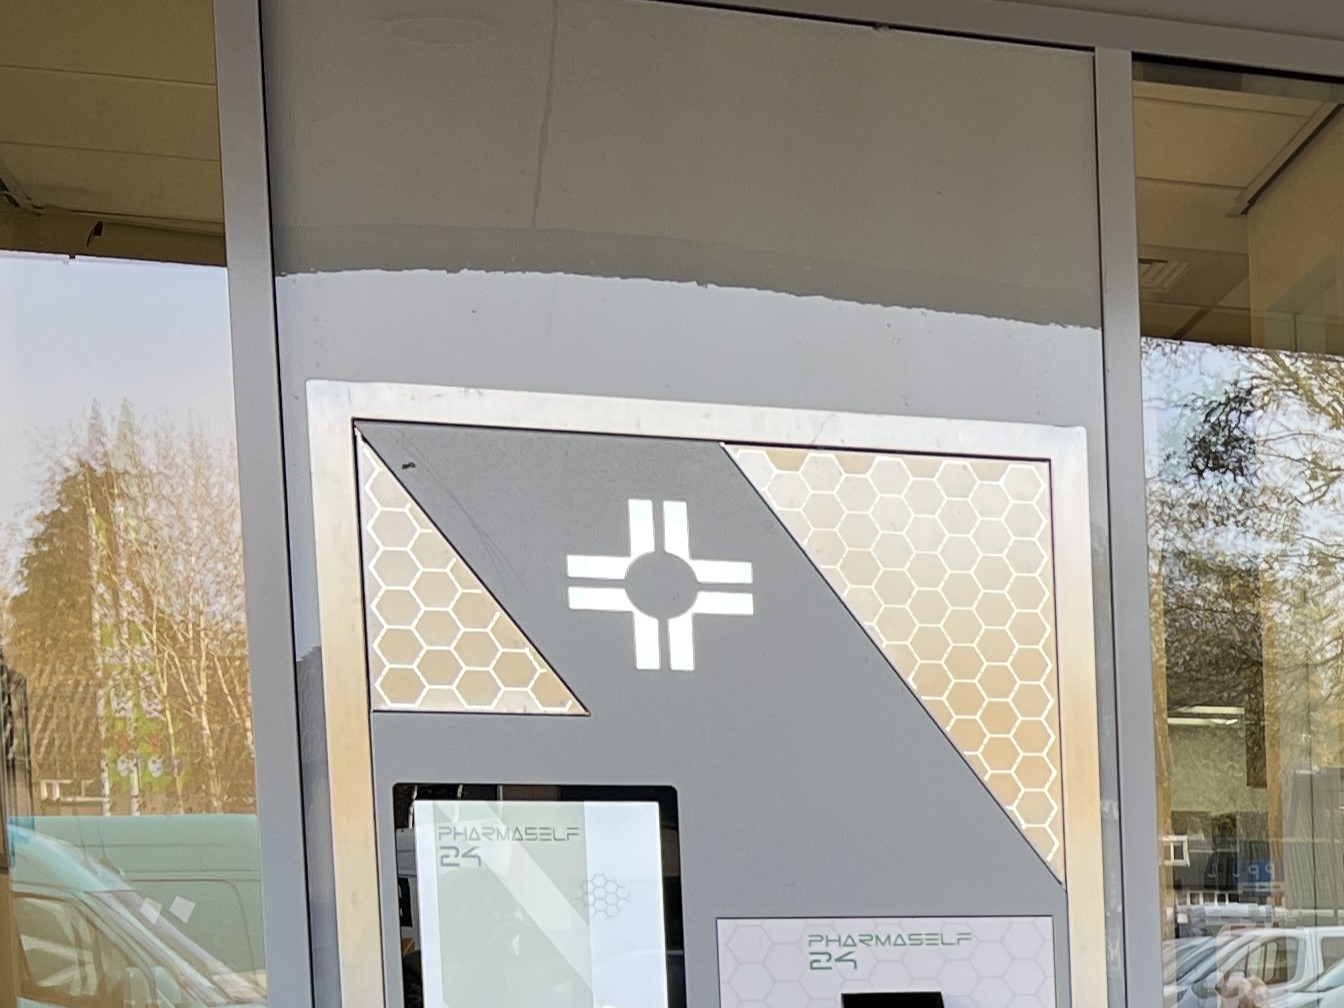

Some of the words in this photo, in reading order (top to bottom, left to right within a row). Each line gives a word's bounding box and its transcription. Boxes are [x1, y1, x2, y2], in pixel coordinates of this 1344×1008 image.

[438, 826, 580, 842] PHARMASELF
[439, 845, 482, 867] 24
[808, 933, 972, 947] PHARMASELF
[809, 951, 857, 970] 24
